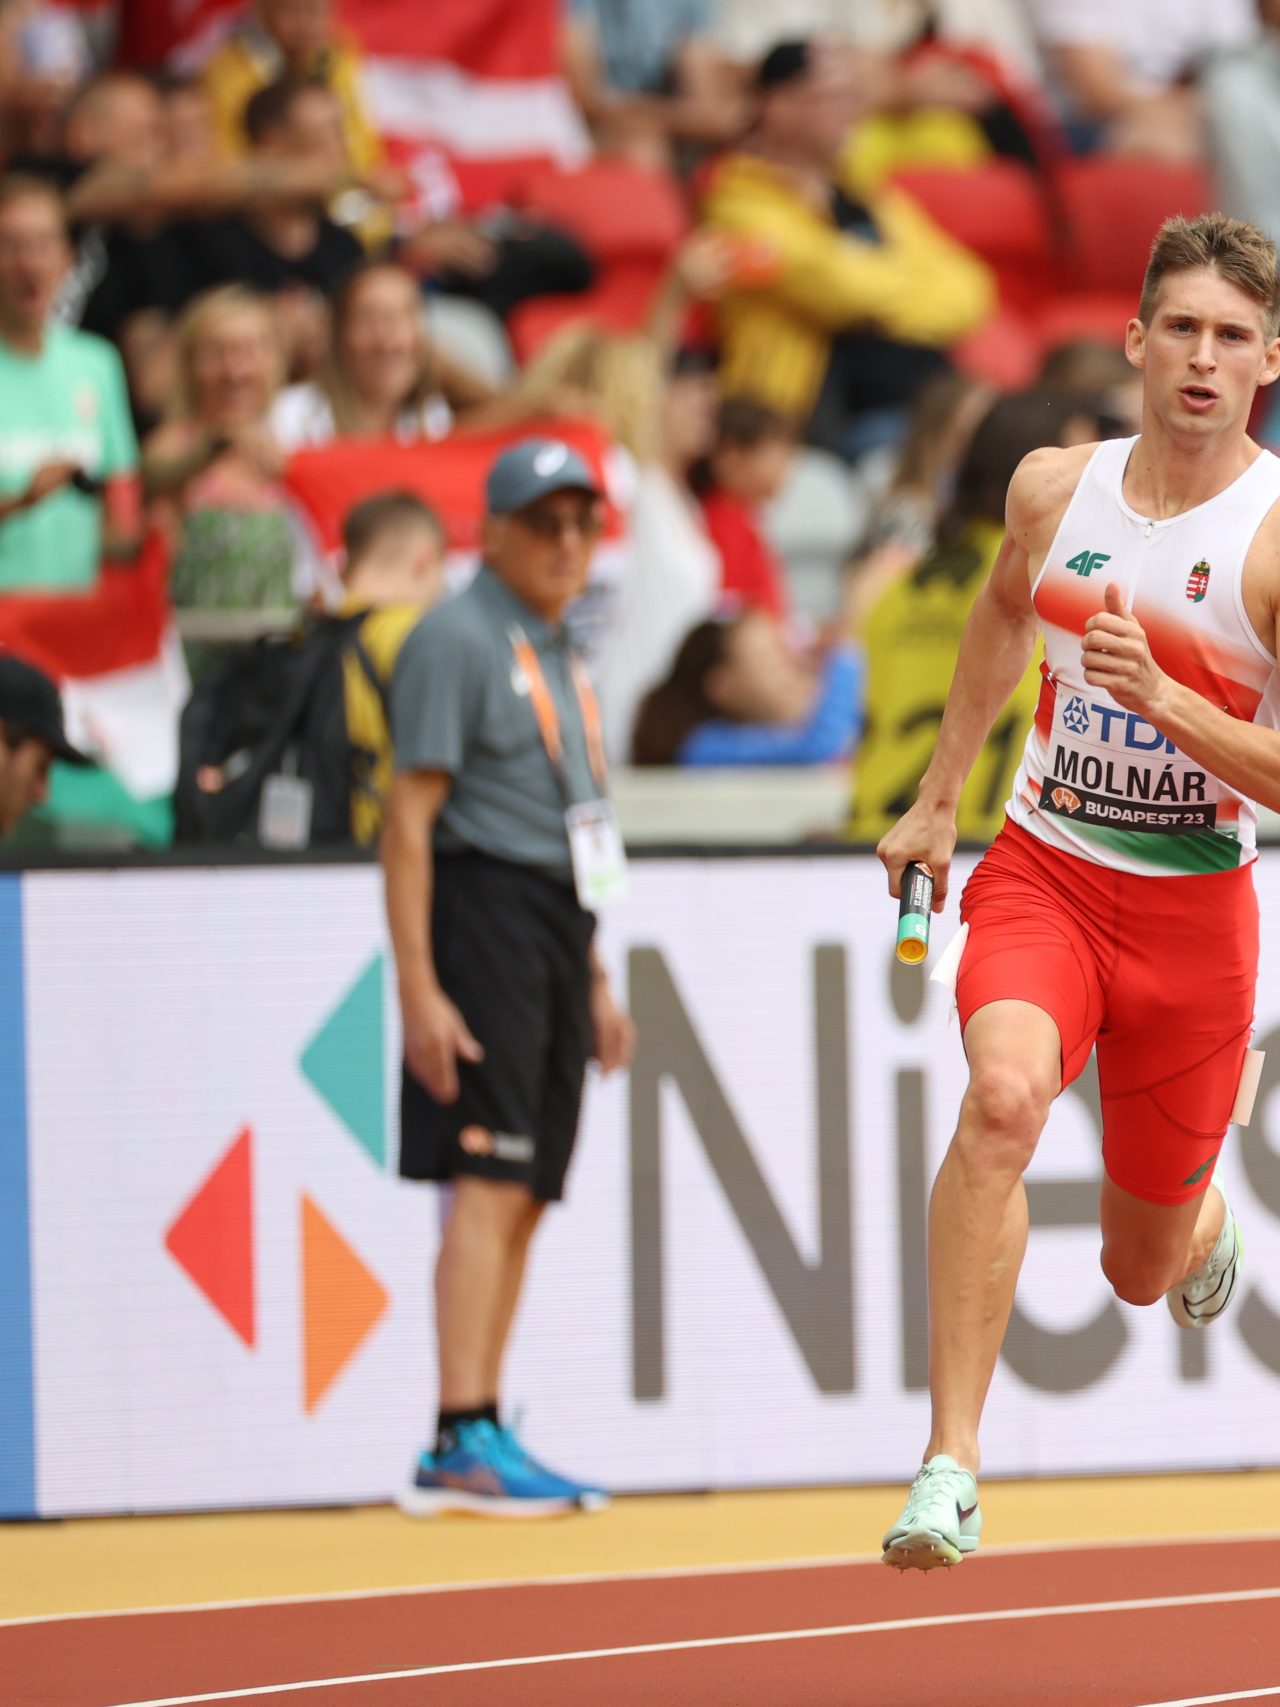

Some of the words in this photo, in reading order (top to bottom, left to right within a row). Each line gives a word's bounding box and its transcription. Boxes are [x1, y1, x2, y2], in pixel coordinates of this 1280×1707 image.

[1065, 550, 1112, 577] 4F
[1090, 703, 1176, 755] TD
[1053, 744, 1207, 802] MOLNÁR
[1085, 800, 1182, 825] BUDAPEST
[1184, 812, 1205, 825] 23
